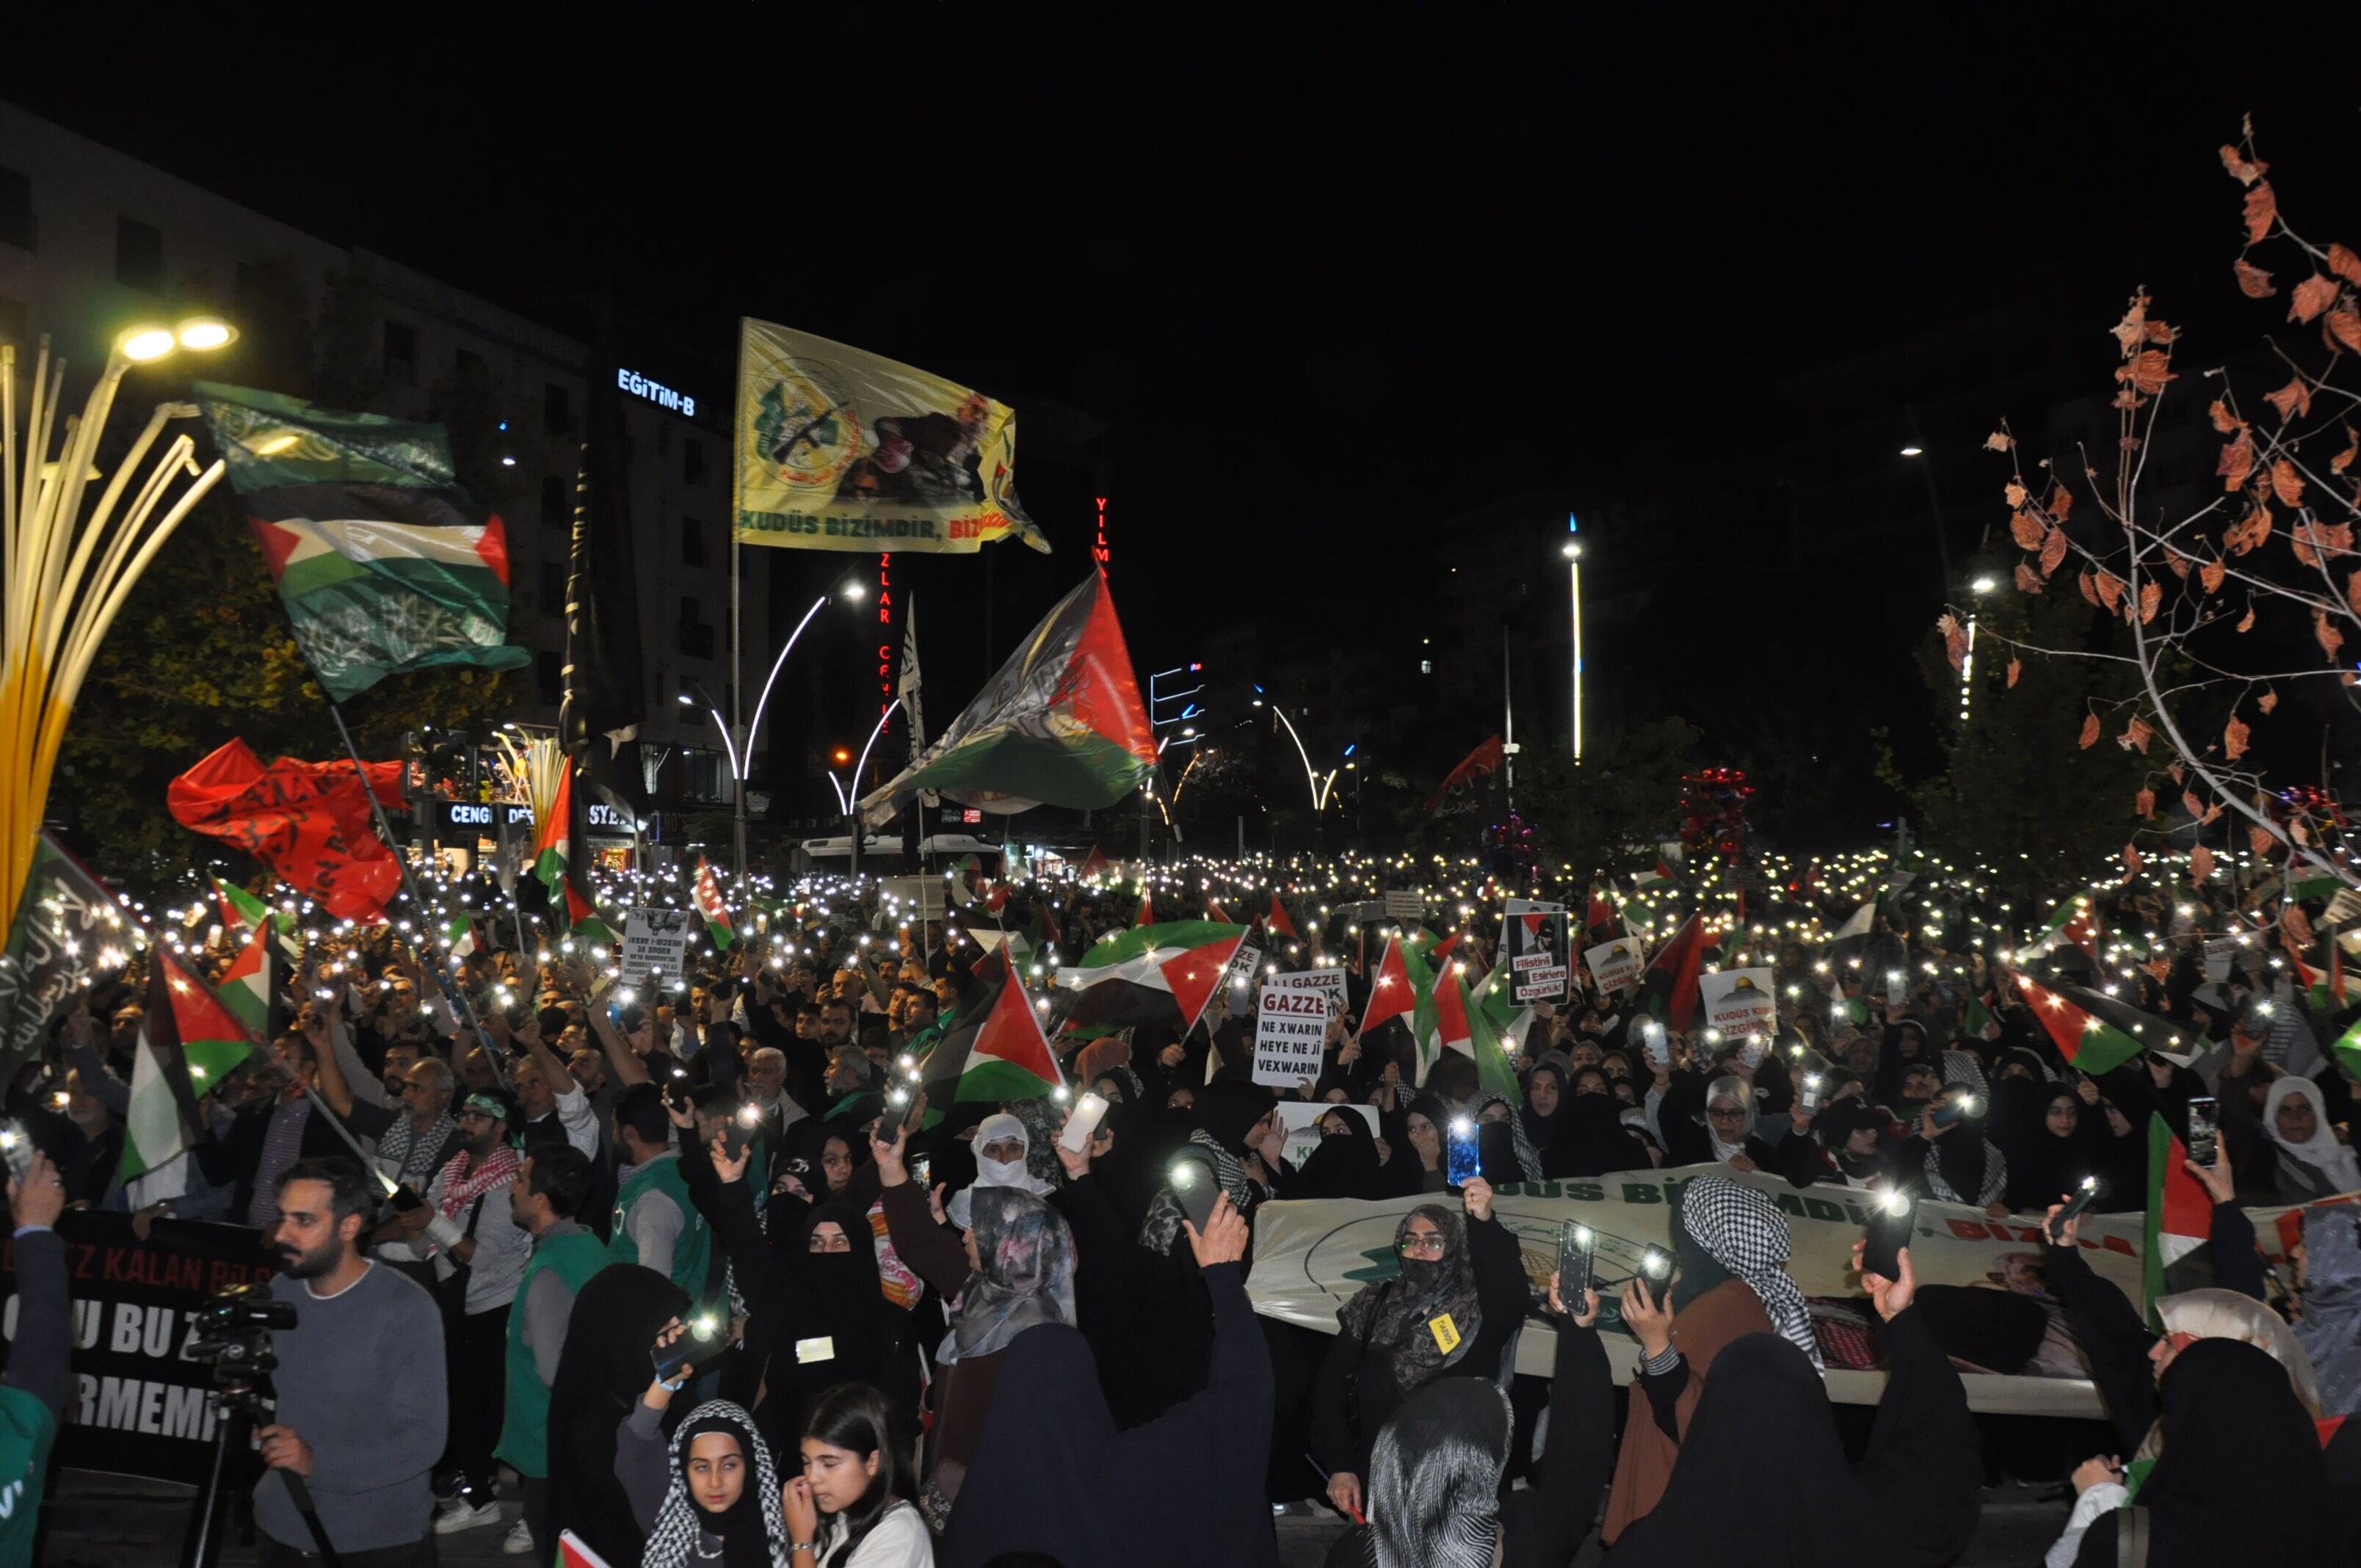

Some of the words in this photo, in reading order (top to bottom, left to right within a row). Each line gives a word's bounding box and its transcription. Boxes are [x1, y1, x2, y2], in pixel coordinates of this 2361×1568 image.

[1263, 993, 1324, 1015] GAZZE
[1261, 1021, 1275, 1033] NE
[1279, 1022, 1322, 1036] XWARIN
[1260, 1039, 1288, 1053] HEYE
[1293, 1042, 1308, 1054] NE
[1258, 1059, 1319, 1075] VEXWARIN
[104, 1246, 204, 1291] KALAN
[110, 1302, 175, 1359] BU
